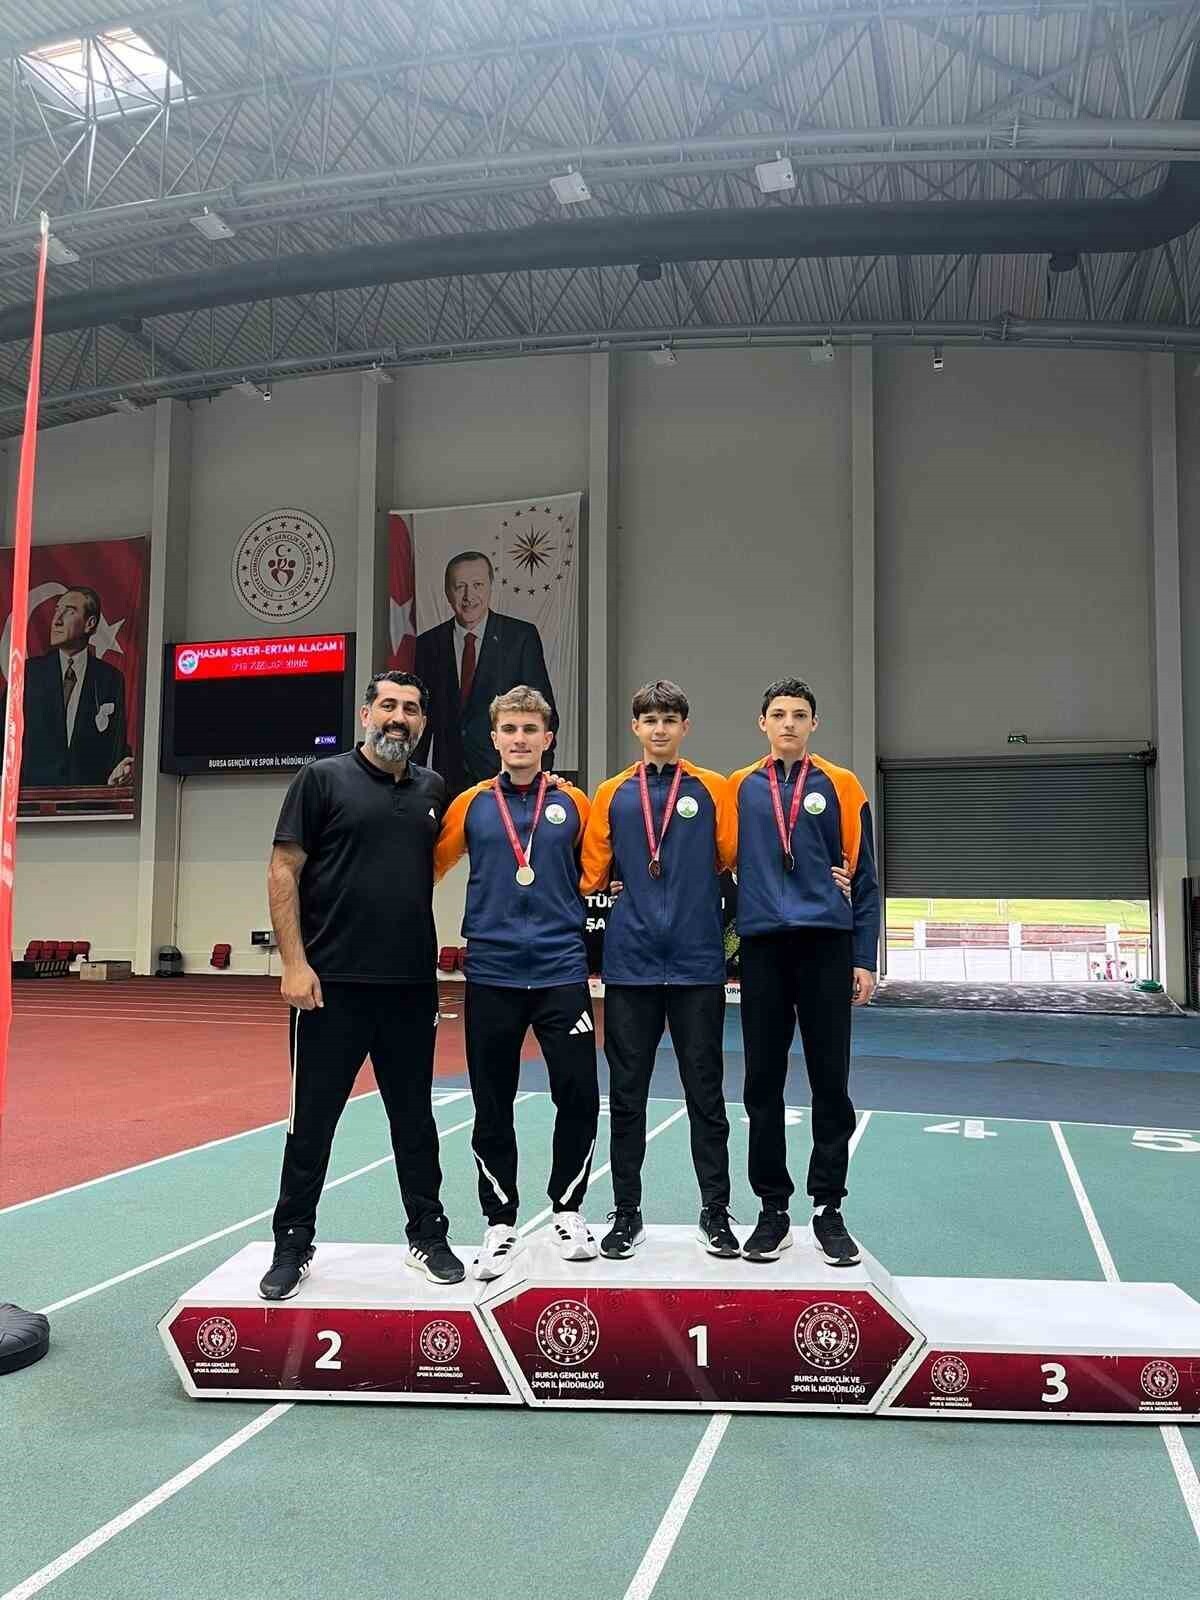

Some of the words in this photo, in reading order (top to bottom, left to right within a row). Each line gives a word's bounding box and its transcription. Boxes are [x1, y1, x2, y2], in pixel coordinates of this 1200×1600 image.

[197, 648, 228, 658] HASAN
[208, 760, 226, 768] BURSA
[228, 758, 250, 768] GENÇLİK
[251, 759, 258, 767] VE
[259, 758, 274, 766] SPOR
[314, 1330, 342, 1370] 2
[688, 1325, 708, 1368] 1
[559, 1371, 590, 1380] GENÇLİK
[819, 1375, 850, 1384] GENÇLİK
[1040, 1362, 1069, 1403] 3
